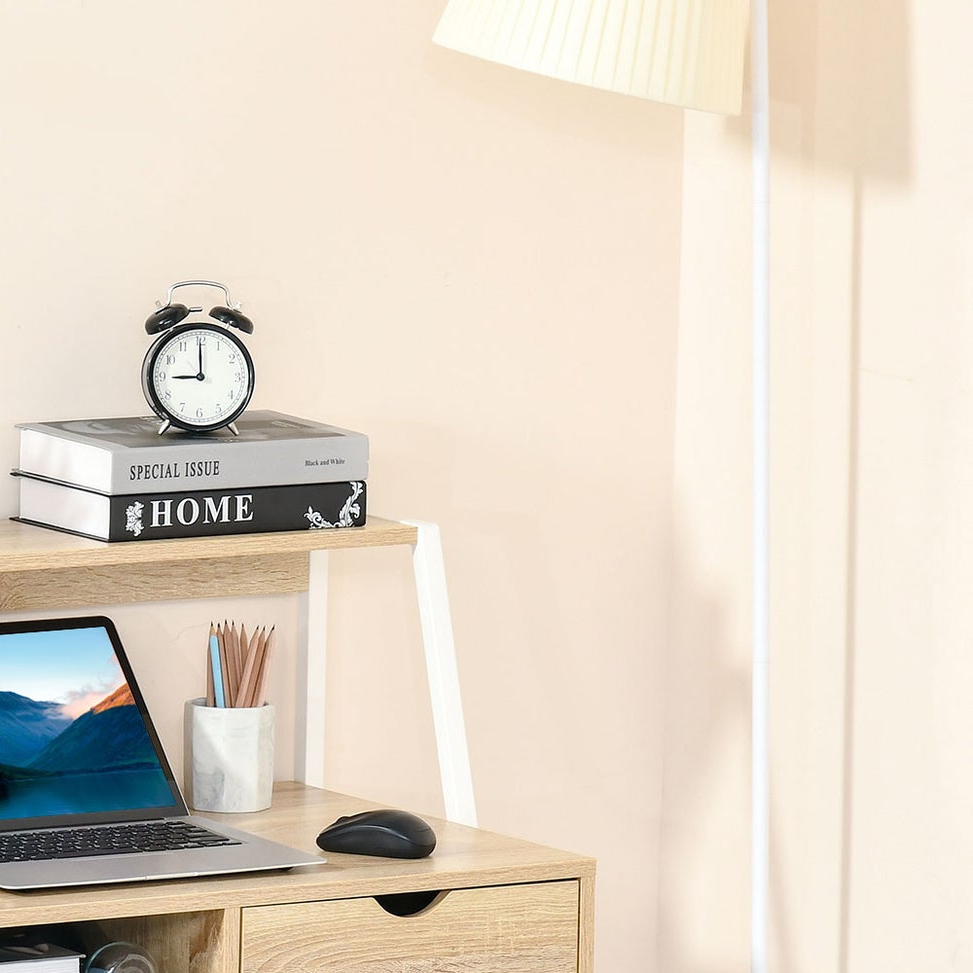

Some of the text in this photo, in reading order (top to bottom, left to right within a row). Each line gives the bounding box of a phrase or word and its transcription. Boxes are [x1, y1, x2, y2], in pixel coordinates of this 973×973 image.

[129, 460, 220, 481] SPECIAL ISSUE
[305, 459, 319, 467] Black
[330, 457, 346, 465] White
[149, 494, 254, 528] HOME
